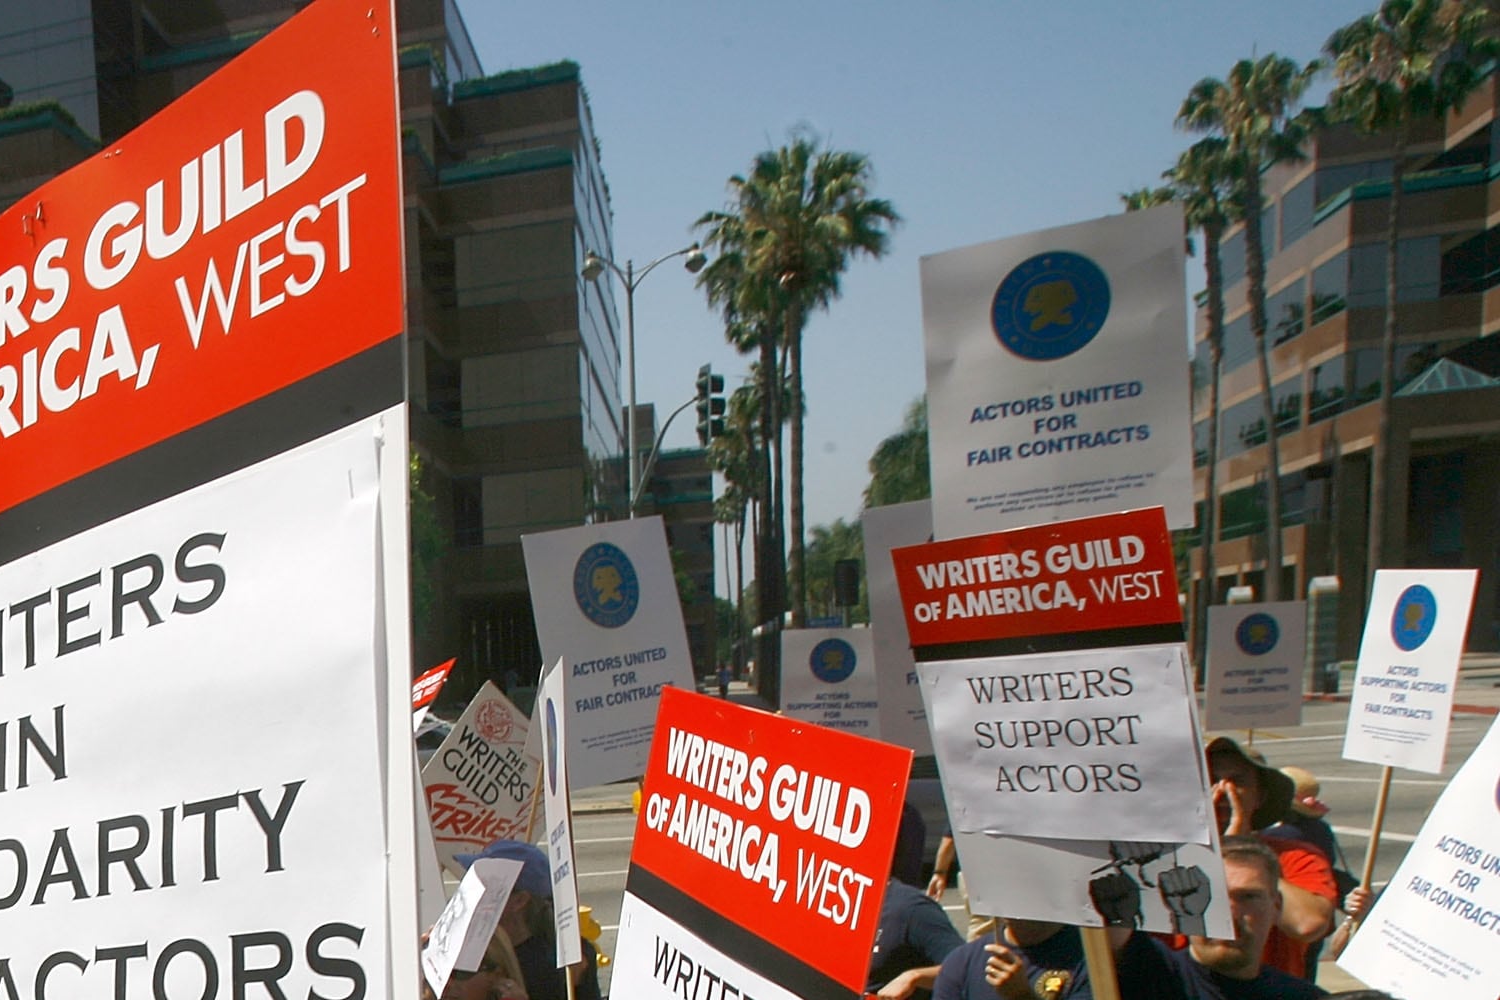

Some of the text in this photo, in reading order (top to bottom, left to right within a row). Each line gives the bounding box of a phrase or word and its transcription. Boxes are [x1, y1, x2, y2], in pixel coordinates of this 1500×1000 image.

[82, 90, 327, 290] GUILD
[175, 174, 367, 350] WEST
[970, 381, 1143, 424] ACTORS UNITED
[1034, 413, 1077, 434] FOR
[967, 424, 1150, 467] FAIR CONTRACTS
[916, 535, 1145, 590] WRITERS GUILD
[914, 570, 1164, 623] OF AMERICA, WEST
[572, 647, 667, 677] ACTORS UNITED
[612, 671, 637, 687] FOR
[1387, 665, 1419, 677] ACTORS
[576, 681, 674, 713] FAIR CONTRAC
[966, 666, 1133, 704] WRITERS
[1410, 681, 1447, 693] ACTORS
[974, 715, 1142, 749] SUPPORT
[443, 748, 498, 805] GUILD
[459, 725, 530, 802] WRITERS
[506, 747, 527, 772] THE
[996, 763, 1142, 793] ACTORS
[666, 727, 872, 849] WRITERS GUILD
[646, 793, 874, 931] OF AMERICA, WEST
[1435, 835, 1482, 865] ACTORS
[1450, 869, 1480, 893] FOR
[1406, 875, 1500, 935] FAIR CONTRACT
